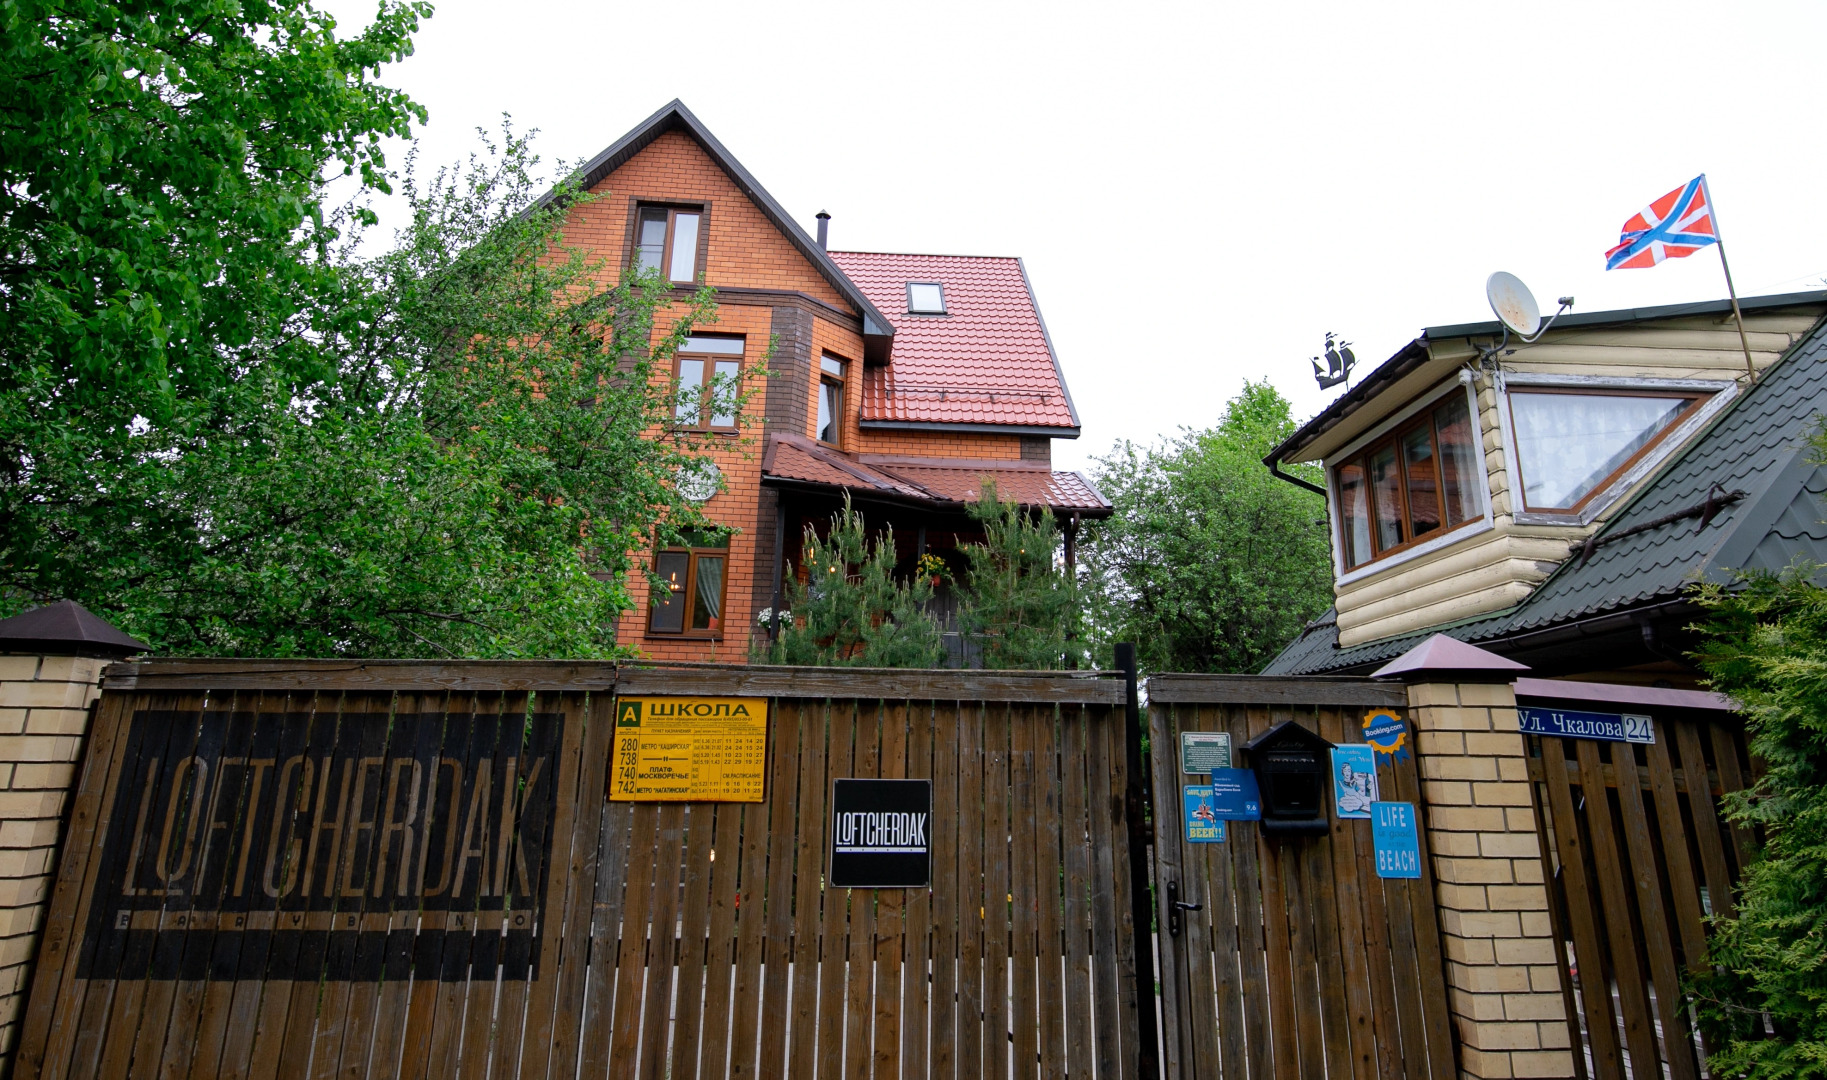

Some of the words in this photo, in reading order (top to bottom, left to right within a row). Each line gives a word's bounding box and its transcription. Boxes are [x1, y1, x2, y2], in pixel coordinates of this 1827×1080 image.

[650, 703, 750, 717] ШКОЛА
[1365, 724, 1404, 737] Booking.com
[1517, 710, 1546, 731] Ул.
[1551, 713, 1624, 737] Чкалова
[1626, 717, 1652, 741] 24
[621, 738, 638, 751] 280
[620, 753, 637, 765] 738
[619, 767, 636, 779] 740
[618, 781, 634, 794] 742
[1379, 806, 1407, 828] LIFE
[122, 755, 546, 899] LOFTCHERDAK
[836, 812, 927, 846] LOFTCHERDAK
[1190, 828, 1222, 838] BEER!!
[1379, 850, 1416, 871] BEACH
